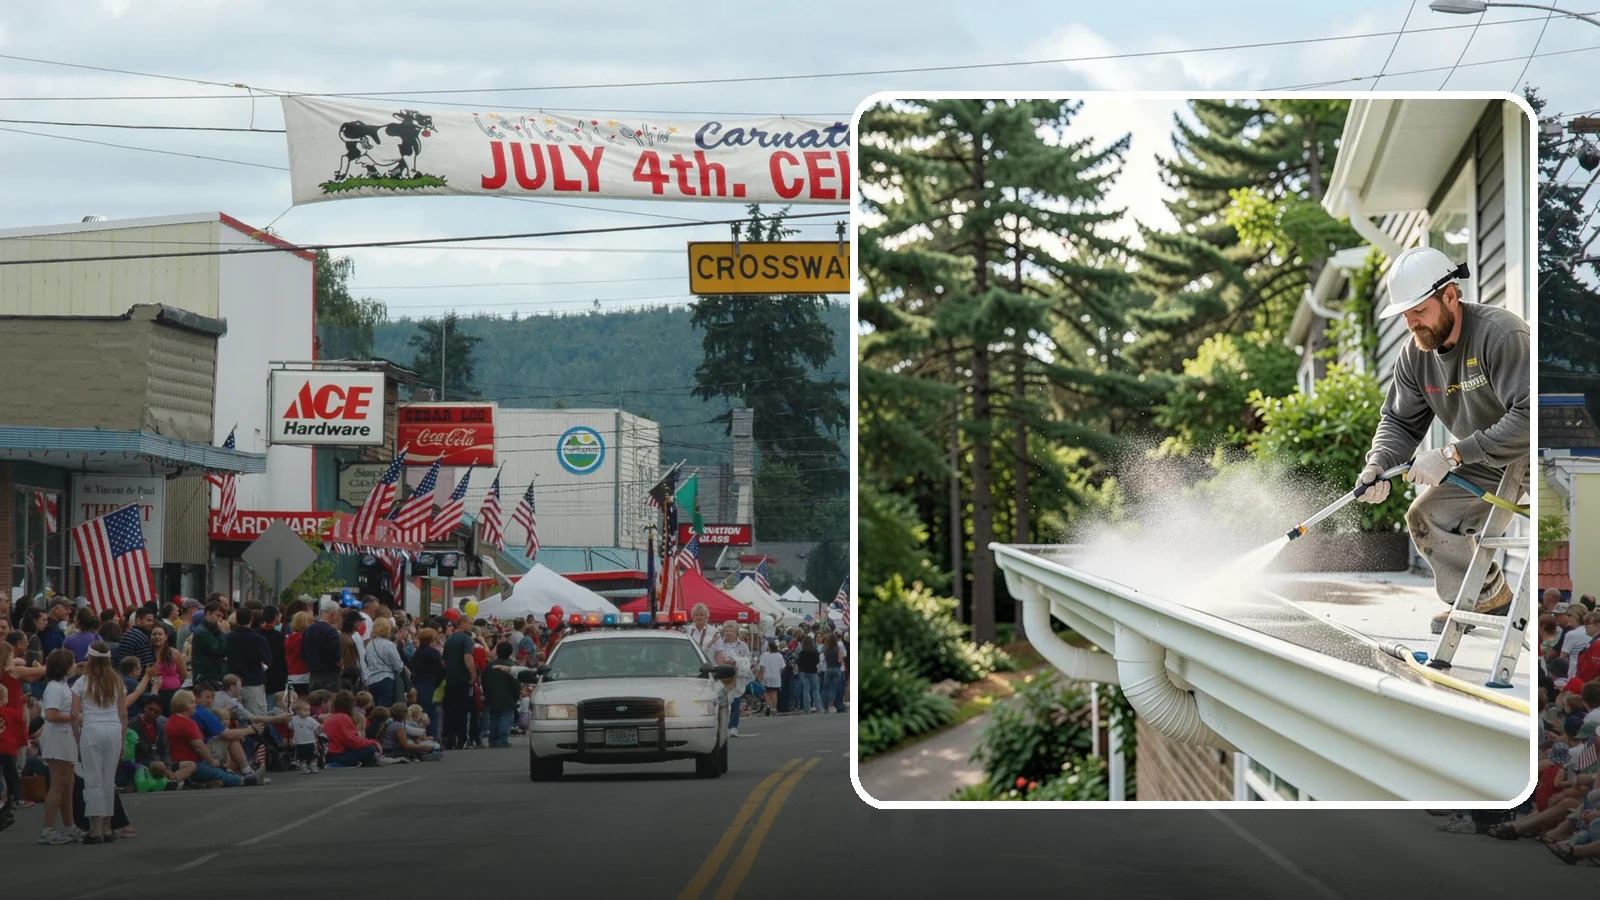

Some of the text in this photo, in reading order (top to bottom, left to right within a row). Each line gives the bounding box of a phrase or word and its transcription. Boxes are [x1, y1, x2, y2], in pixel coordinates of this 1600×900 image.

[481, 141, 605, 192] JULY
[632, 150, 746, 197] 4th.
[697, 254, 850, 280] CROSSWA
[282, 380, 373, 420] ACE
[405, 409, 452, 422] CEDAR
[283, 421, 371, 437] Hardware
[416, 428, 478, 447] Coca-Cola
[353, 467, 385, 479] Simpl
[83, 485, 155, 495] St. Vincent de Paul
[688, 526, 742, 535] CRNATION
[698, 535, 730, 543] GLASS
